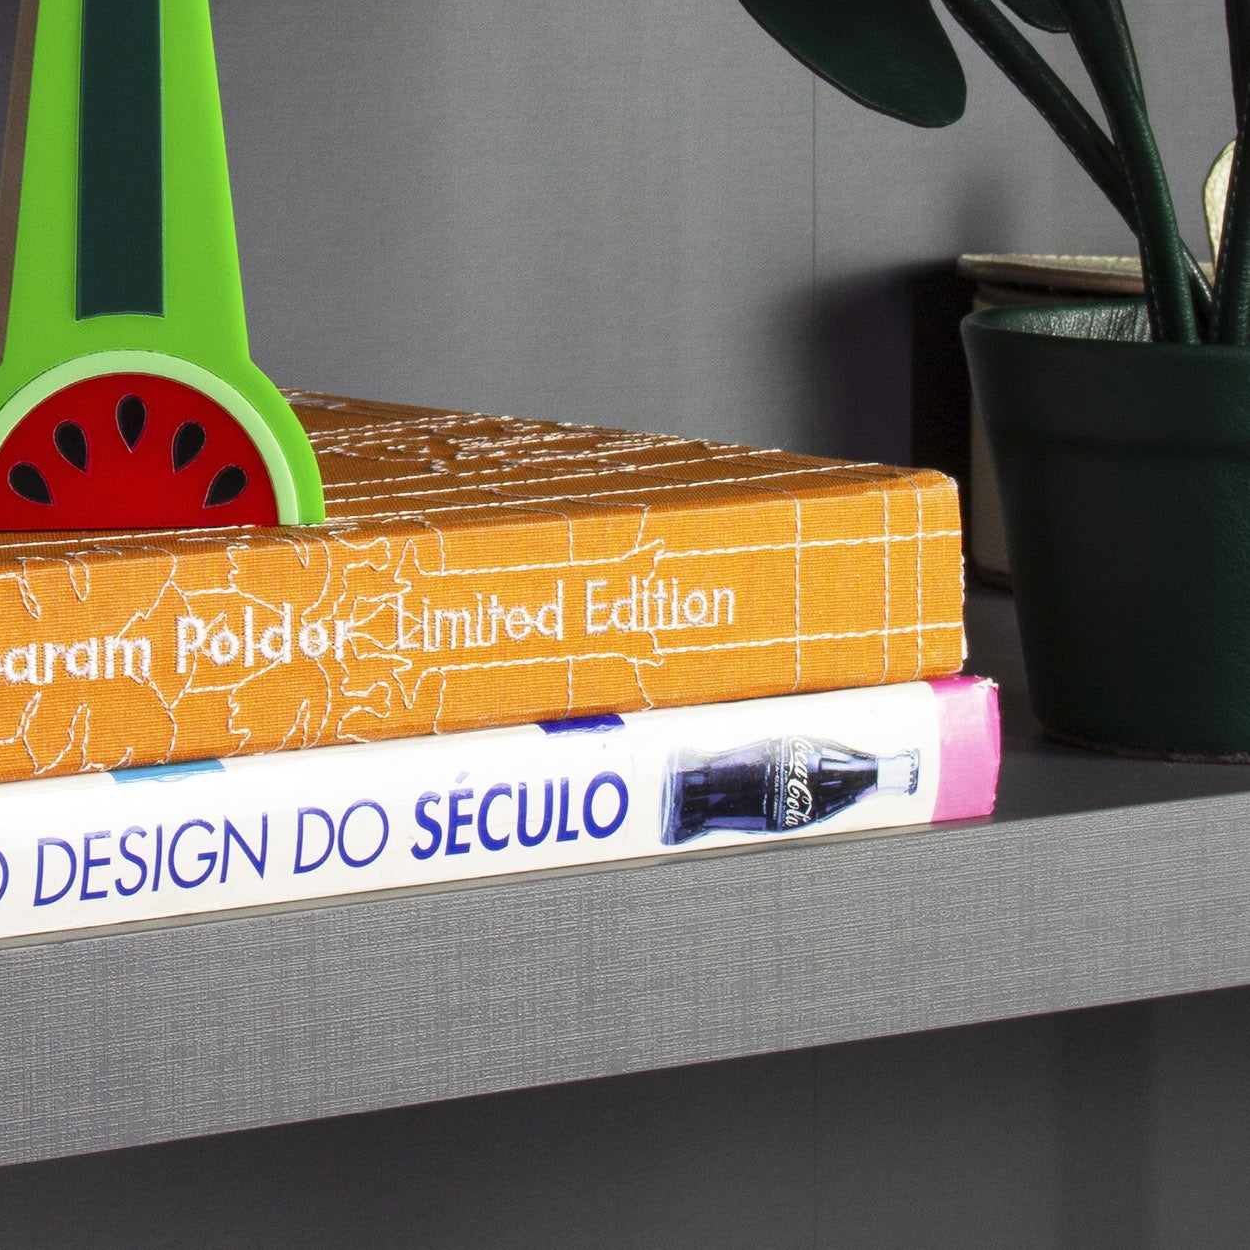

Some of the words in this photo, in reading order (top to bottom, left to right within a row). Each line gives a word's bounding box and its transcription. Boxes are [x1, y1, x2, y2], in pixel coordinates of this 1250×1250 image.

[174, 602, 354, 674] Polder
[395, 579, 565, 652] Limited
[584, 574, 735, 635] Edition
[33, 814, 269, 907] DESIGN
[293, 799, 390, 875] DO
[410, 771, 630, 861] SÉCULO
